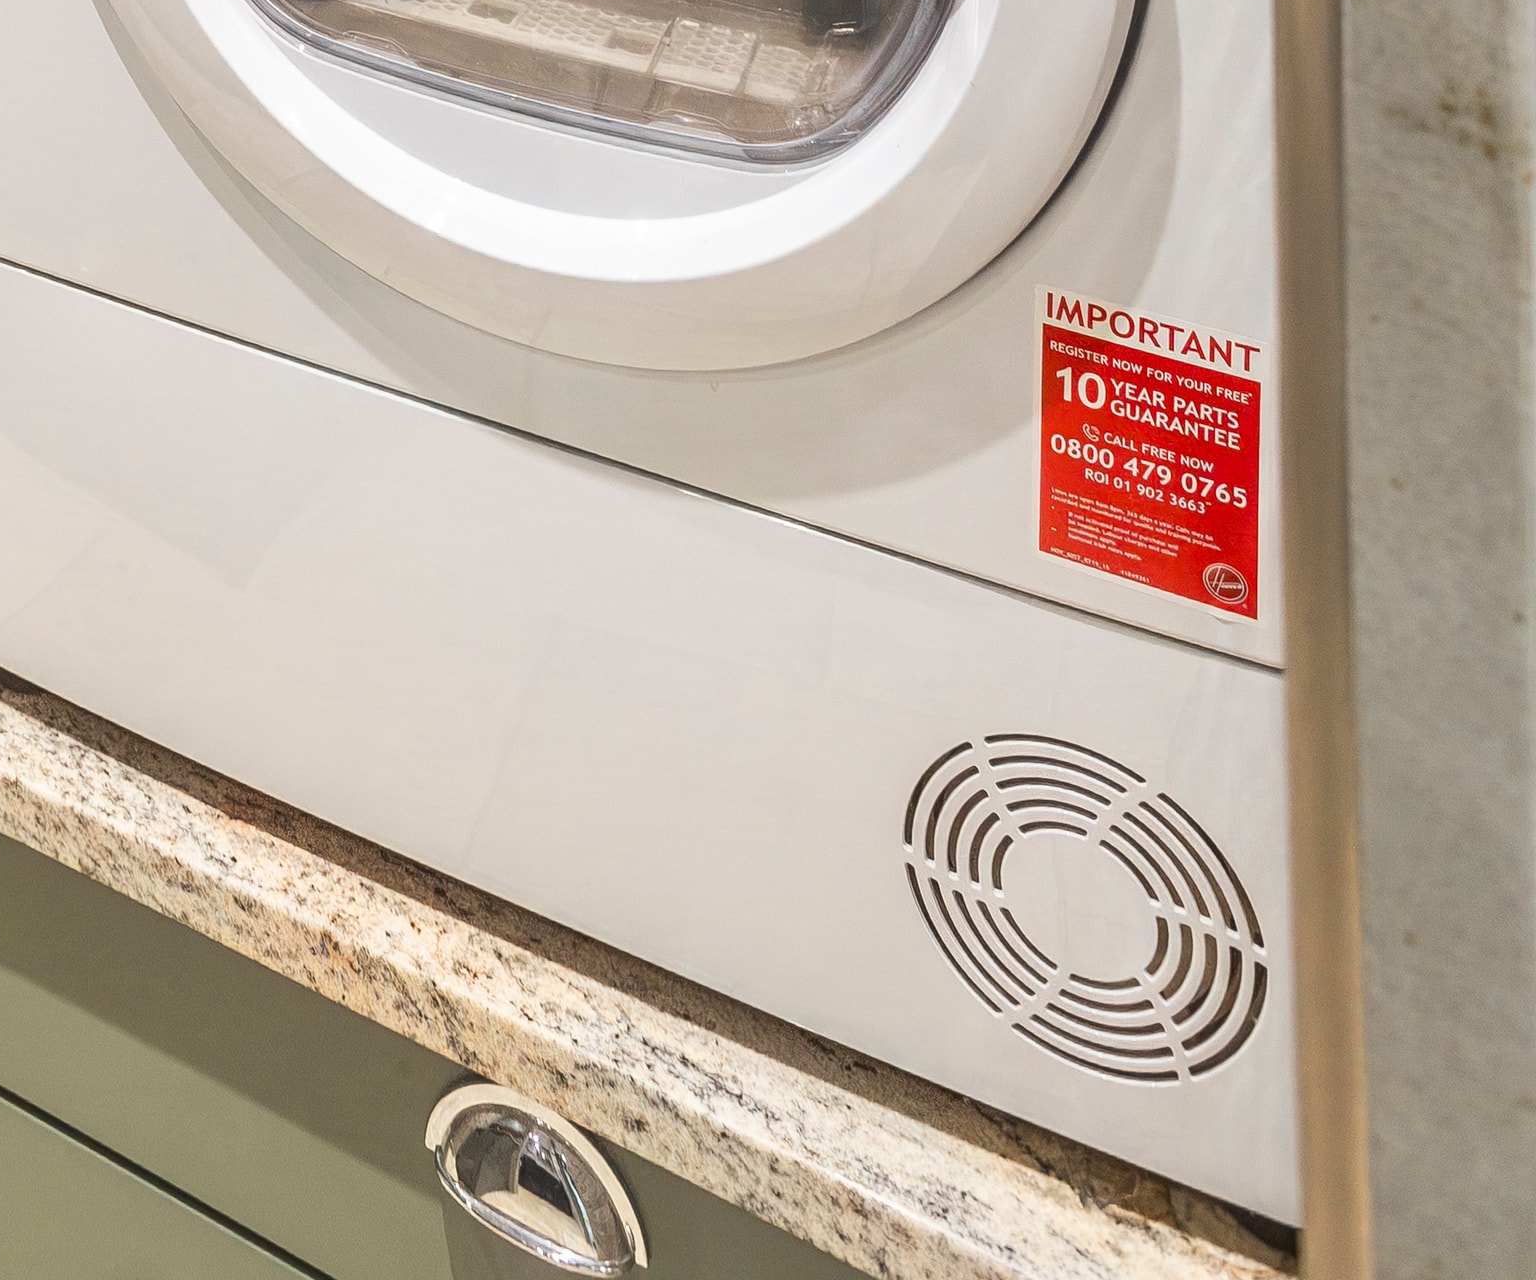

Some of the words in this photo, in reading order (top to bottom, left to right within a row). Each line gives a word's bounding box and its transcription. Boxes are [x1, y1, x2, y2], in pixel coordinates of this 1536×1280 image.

[1046, 292, 1261, 372] IMPORTANT
[1050, 340, 1108, 366] REGISTER
[1112, 358, 1144, 375] NOW
[1146, 367, 1174, 384] FOR
[1176, 374, 1212, 395] YOUR
[1056, 366, 1106, 410] 10
[1110, 399, 1242, 450] GUARANTEE
[1111, 378, 1166, 410] YEAR
[1172, 396, 1240, 429] PARTS
[1050, 433, 1114, 469] 0800
[1122, 456, 1172, 486] 479
[1180, 472, 1248, 509] 0765
[1104, 432, 1138, 452] CALL
[1142, 442, 1176, 464] FREE
[1180, 453, 1214, 473] NOW
[1084, 468, 1110, 486] ROI
[1114, 478, 1130, 492] 01
[1136, 484, 1164, 502] 902
